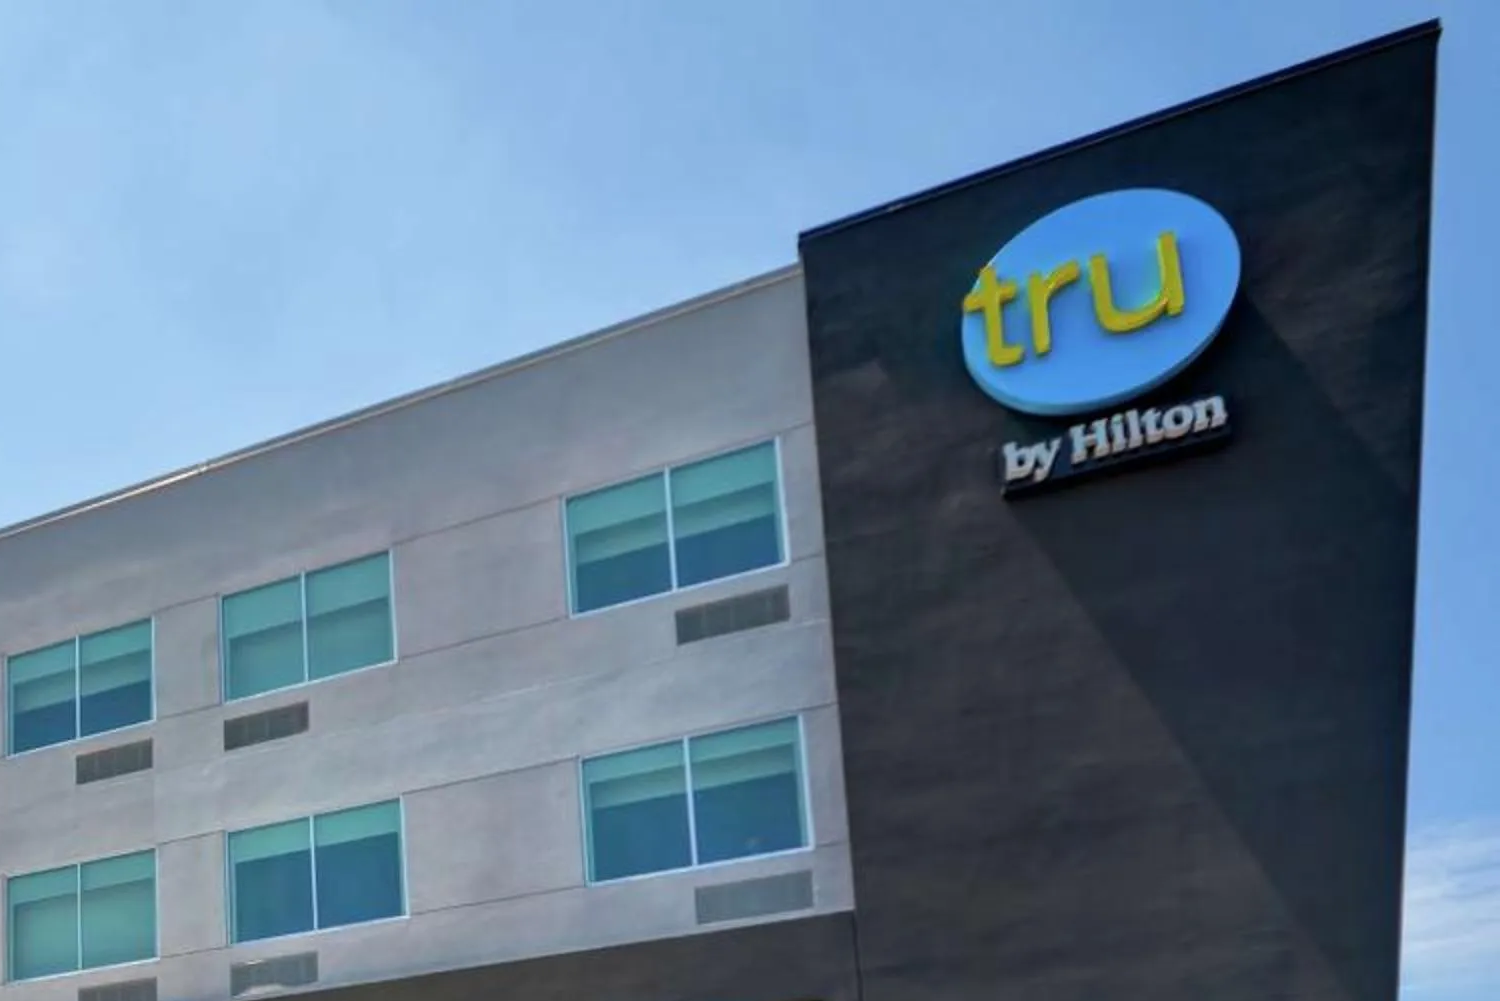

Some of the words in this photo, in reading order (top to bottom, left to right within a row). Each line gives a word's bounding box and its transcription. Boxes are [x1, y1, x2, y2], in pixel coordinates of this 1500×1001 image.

[961, 229, 1185, 367] tru
[1002, 438, 1062, 483] by
[1069, 395, 1229, 465] Hilton
